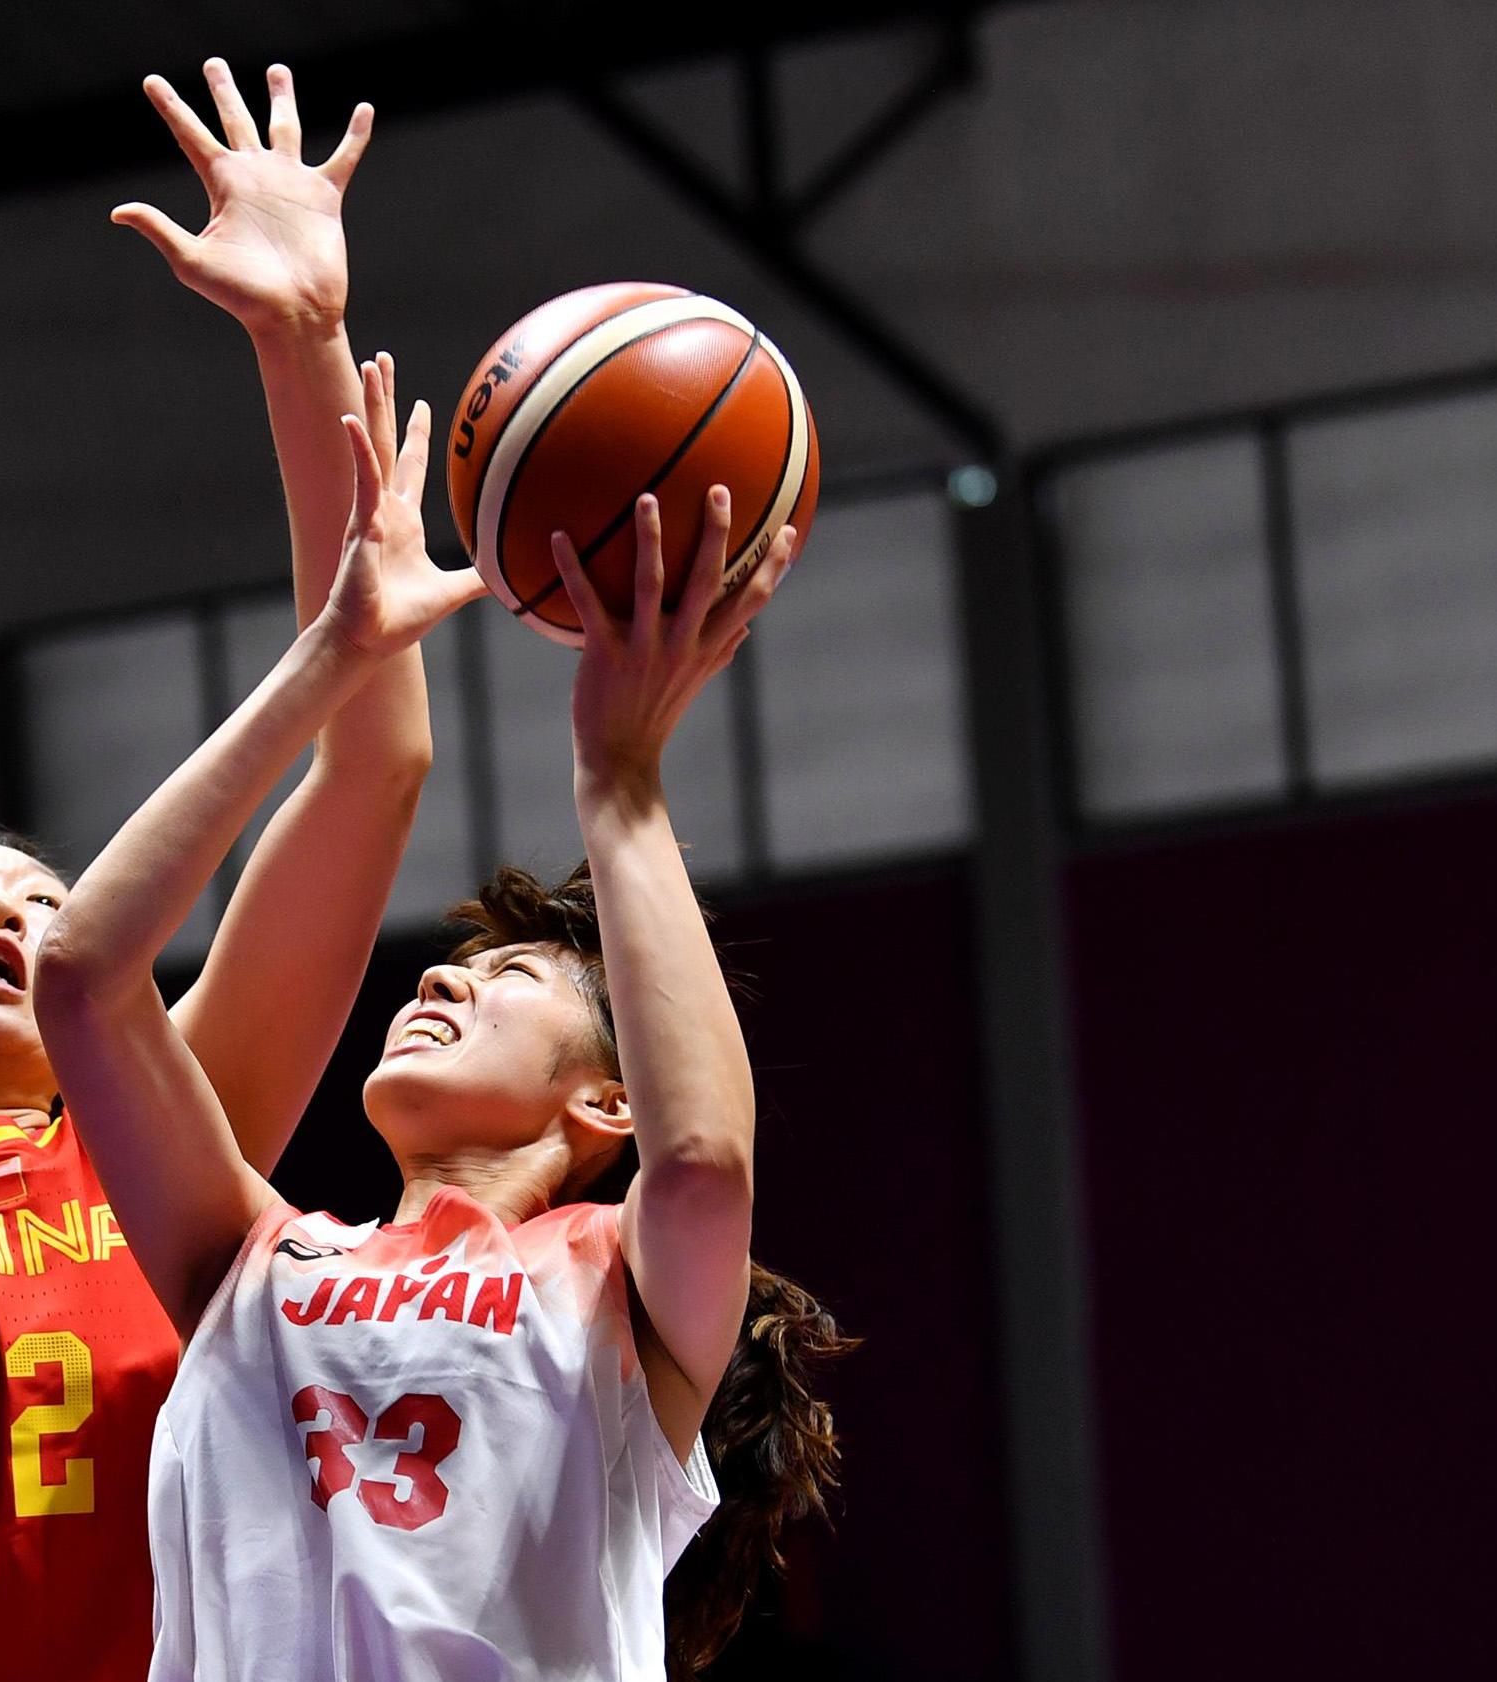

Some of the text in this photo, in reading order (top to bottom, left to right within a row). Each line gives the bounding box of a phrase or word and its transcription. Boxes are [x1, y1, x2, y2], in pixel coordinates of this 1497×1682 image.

[455, 336, 524, 458] lten
[281, 1267, 523, 1336] JAPAN
[291, 1384, 462, 1531] 33
